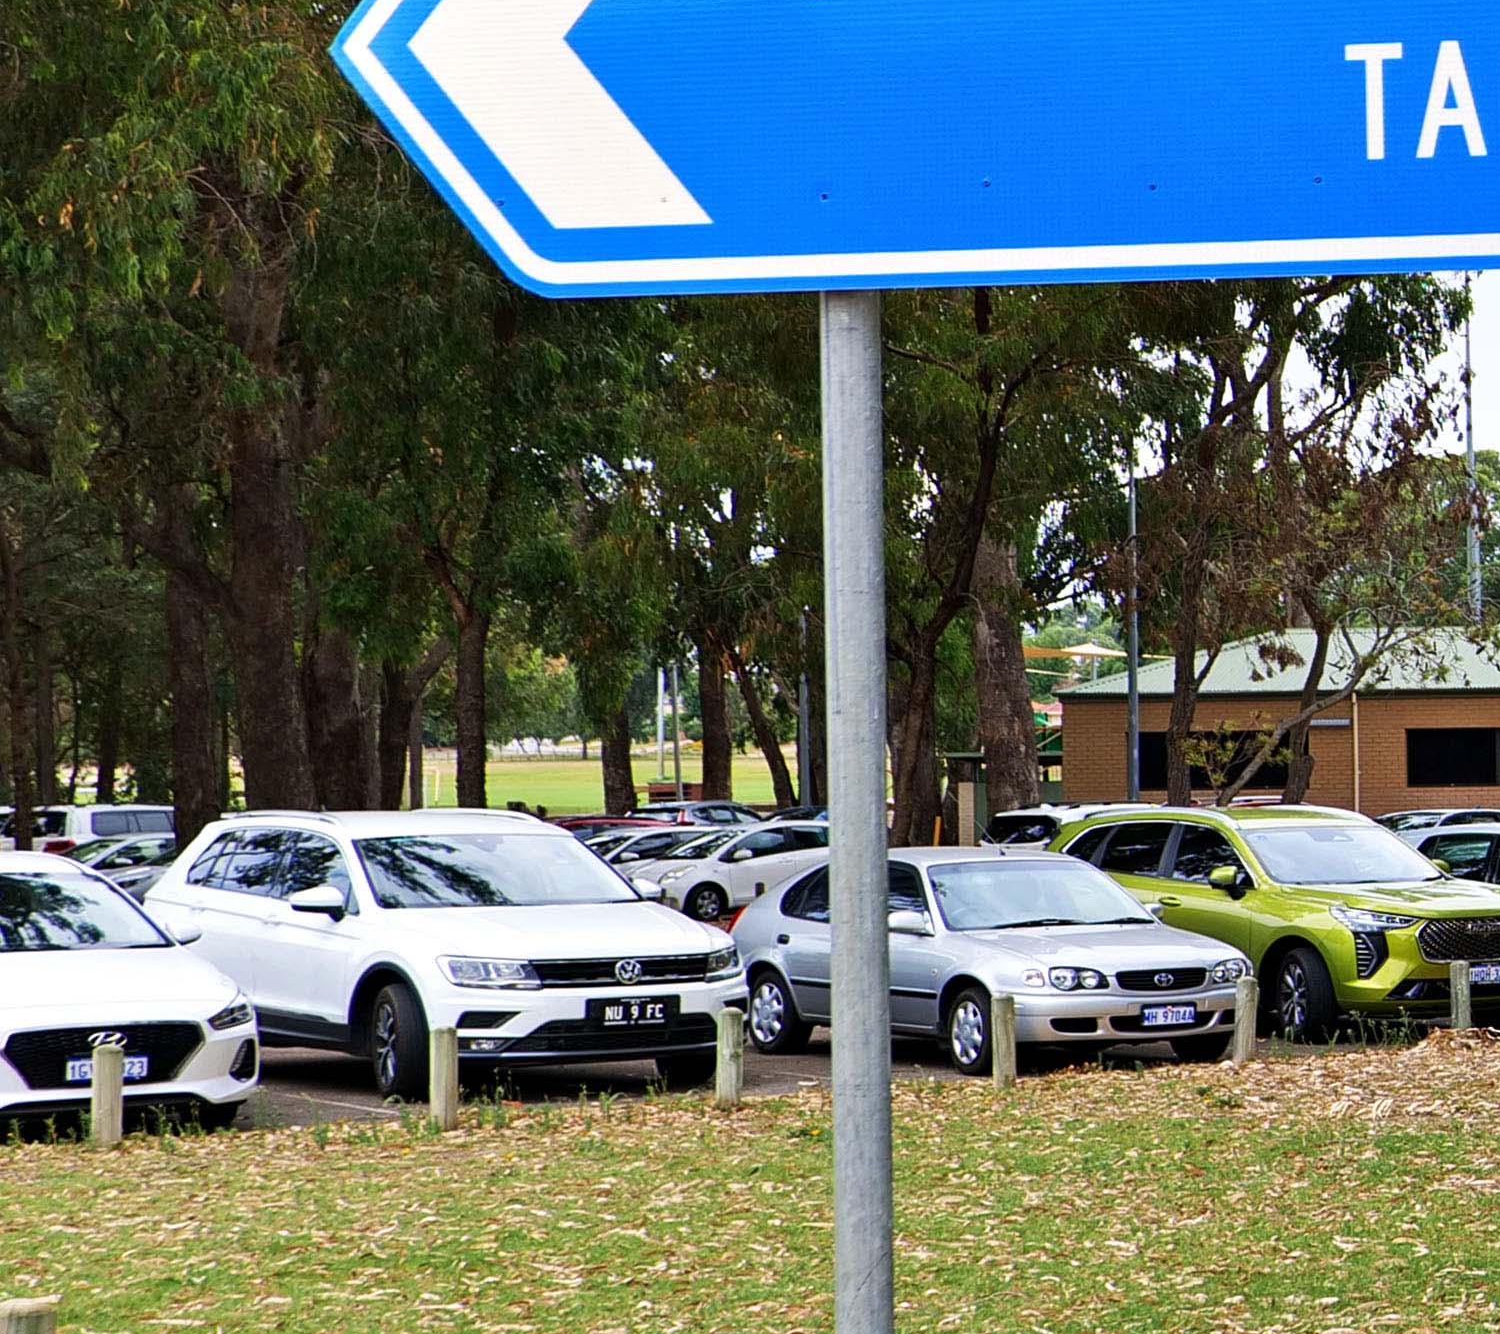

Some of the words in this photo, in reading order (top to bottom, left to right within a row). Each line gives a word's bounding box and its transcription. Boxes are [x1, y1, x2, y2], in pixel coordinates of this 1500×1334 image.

[605, 1006, 623, 1021] NU
[630, 1005, 639, 1019] 9
[646, 1004, 664, 1019] FC
